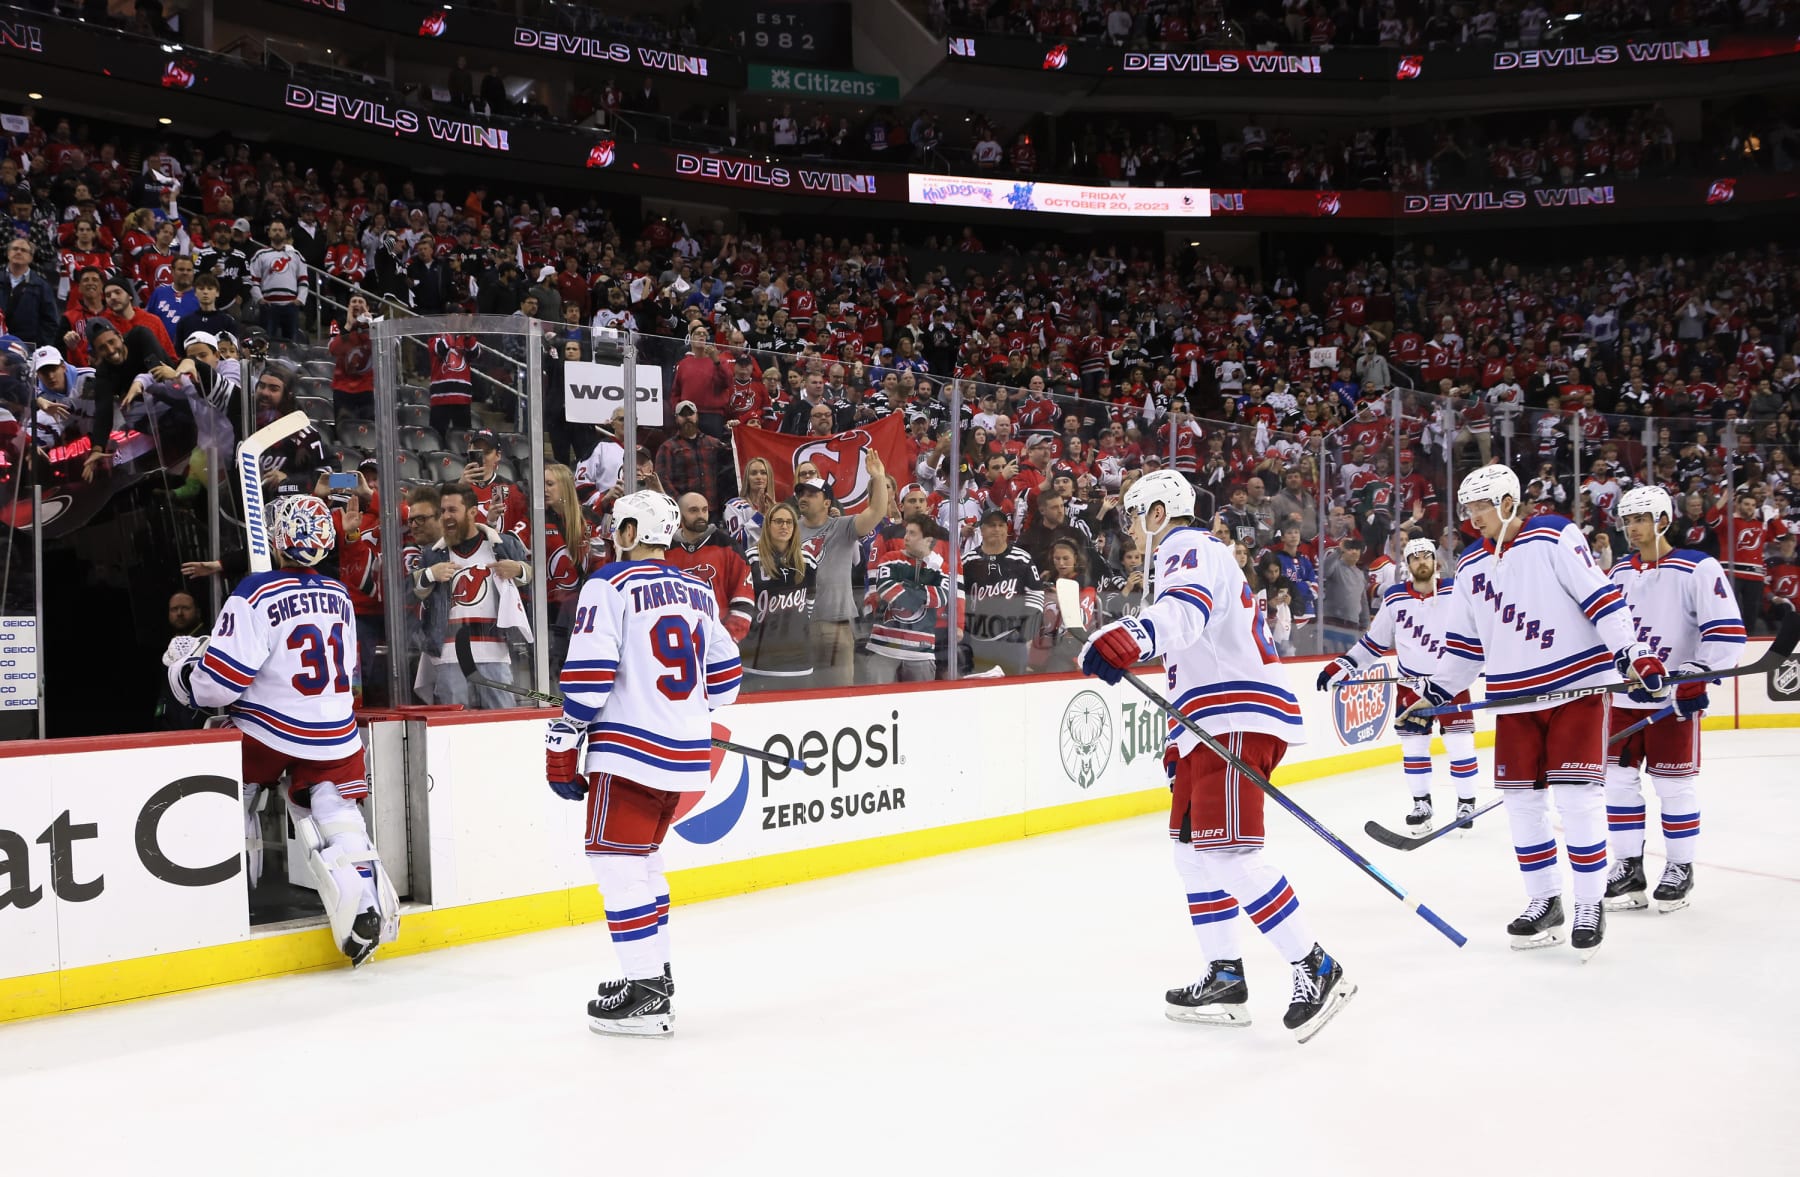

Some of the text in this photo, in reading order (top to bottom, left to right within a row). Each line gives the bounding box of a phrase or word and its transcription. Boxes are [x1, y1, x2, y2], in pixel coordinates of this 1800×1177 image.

[514, 27, 708, 76] DEVILS WIN!
[738, 30, 815, 50] 1982
[1494, 39, 1711, 70] DEVILS WIN!
[1123, 52, 1322, 74] DEVILS WIN!
[793, 72, 876, 95] Citizens
[286, 84, 509, 151] DEVILS WIN!
[675, 153, 877, 194] DEVILS WIN!
[1044, 198, 1106, 211] OCTOBER
[1109, 201, 1132, 212] 20,
[1135, 201, 1170, 211] 2023
[1080, 191, 1127, 201] FRIDAY
[1404, 186, 1615, 213] DEVILS WIN!
[569, 384, 659, 403] WOO!
[242, 452, 266, 556] WARRIOR
[1163, 548, 1198, 578] 24
[757, 587, 807, 623] Jersey
[971, 578, 1018, 611] Jersey
[217, 612, 236, 637] 31
[573, 605, 598, 634] 91
[1472, 572, 1555, 650] RANGERS
[4, 646, 36, 654] GEICO
[286, 622, 350, 696] 31
[649, 615, 709, 701] 91
[4, 672, 37, 680] GEICO
[5, 698, 38, 707] GEICO
[1357, 727, 1374, 740] SUBS
[762, 710, 899, 798] pepsi
[762, 788, 906, 830] ZERO SUGAR
